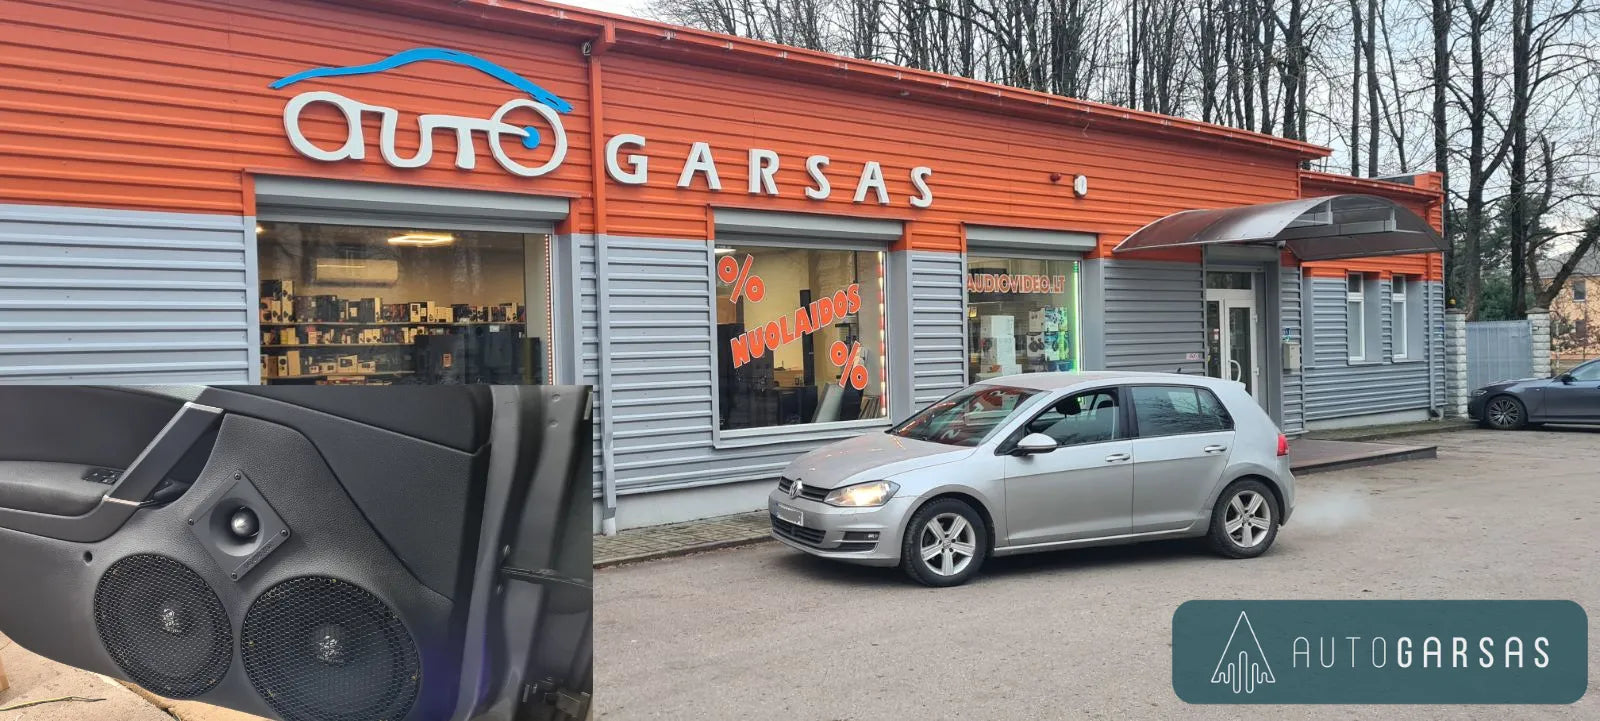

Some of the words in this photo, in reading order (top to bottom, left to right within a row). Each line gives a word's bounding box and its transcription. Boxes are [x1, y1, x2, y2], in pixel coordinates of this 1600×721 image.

[604, 133, 933, 209] GARSAS
[717, 253, 765, 304] %
[967, 273, 1066, 294] AUDIOVIDEO.LT
[730, 283, 862, 369] NUOLAIDOS
[830, 340, 869, 391] %
